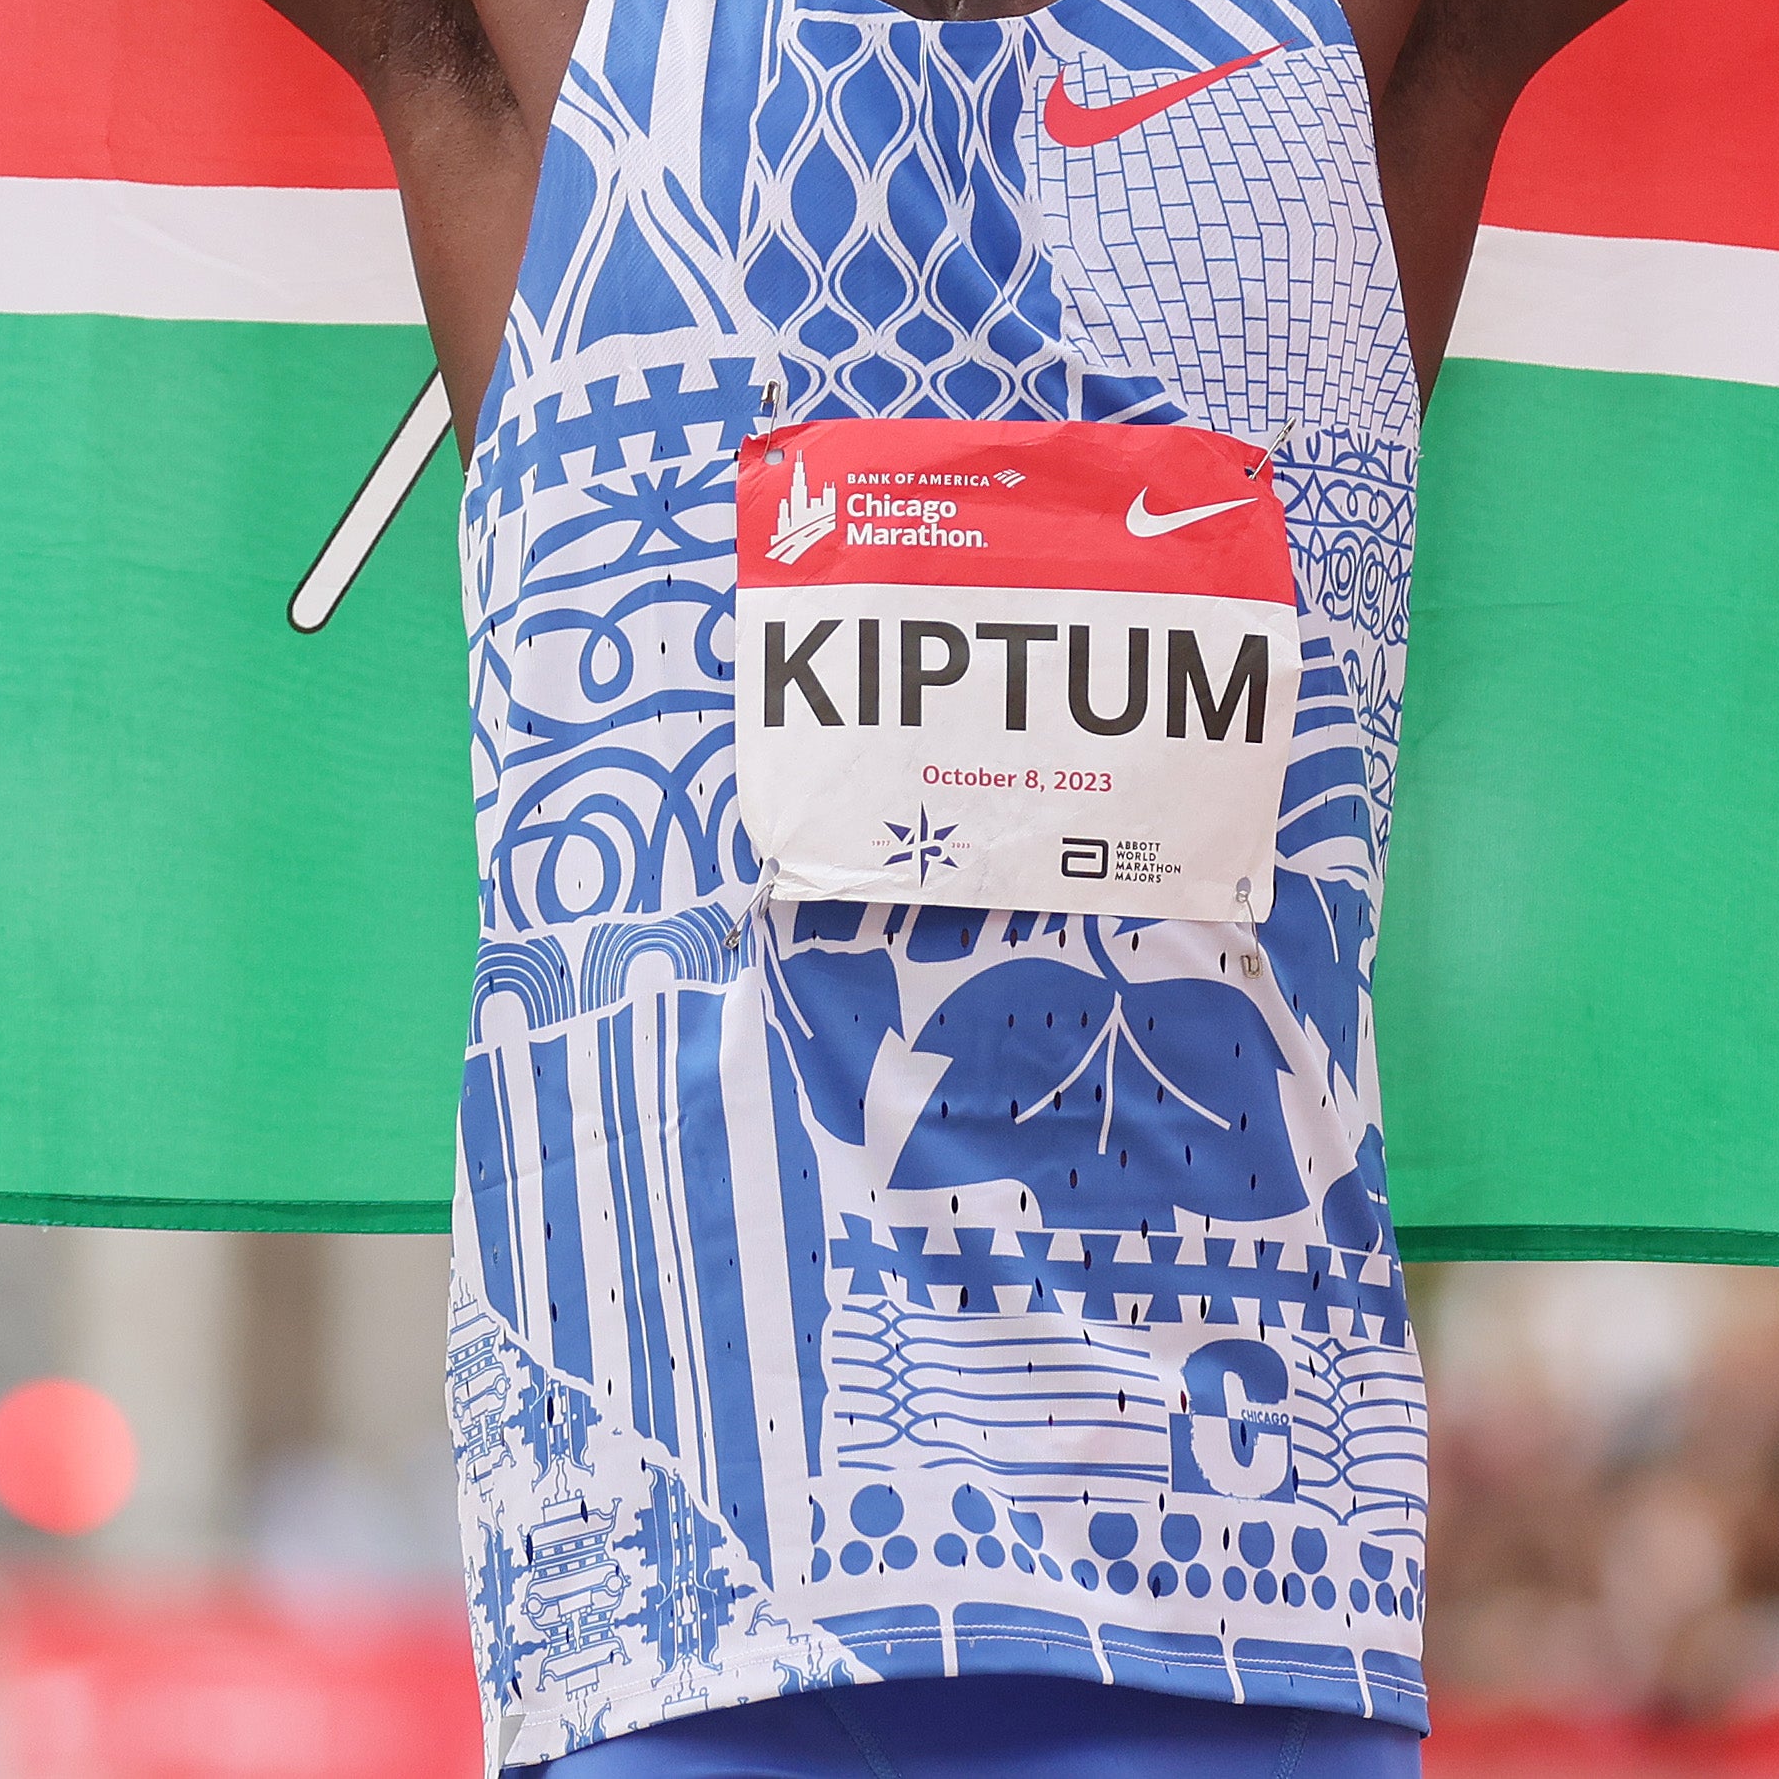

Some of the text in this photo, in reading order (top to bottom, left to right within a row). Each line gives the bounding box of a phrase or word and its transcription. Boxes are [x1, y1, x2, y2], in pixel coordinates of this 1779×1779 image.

[846, 472, 990, 487] BANK OF AMERICA
[846, 492, 958, 524] Chicago
[762, 617, 1270, 744] KIPTUM
[922, 764, 1113, 793] October 8, 2023
[1116, 840, 1162, 852] ABBOTT
[1116, 850, 1157, 862] WORLD
[1115, 862, 1182, 874] MARATHON
[1114, 872, 1163, 884] MAJORS
[1241, 1409, 1290, 1426] CHICAGO
